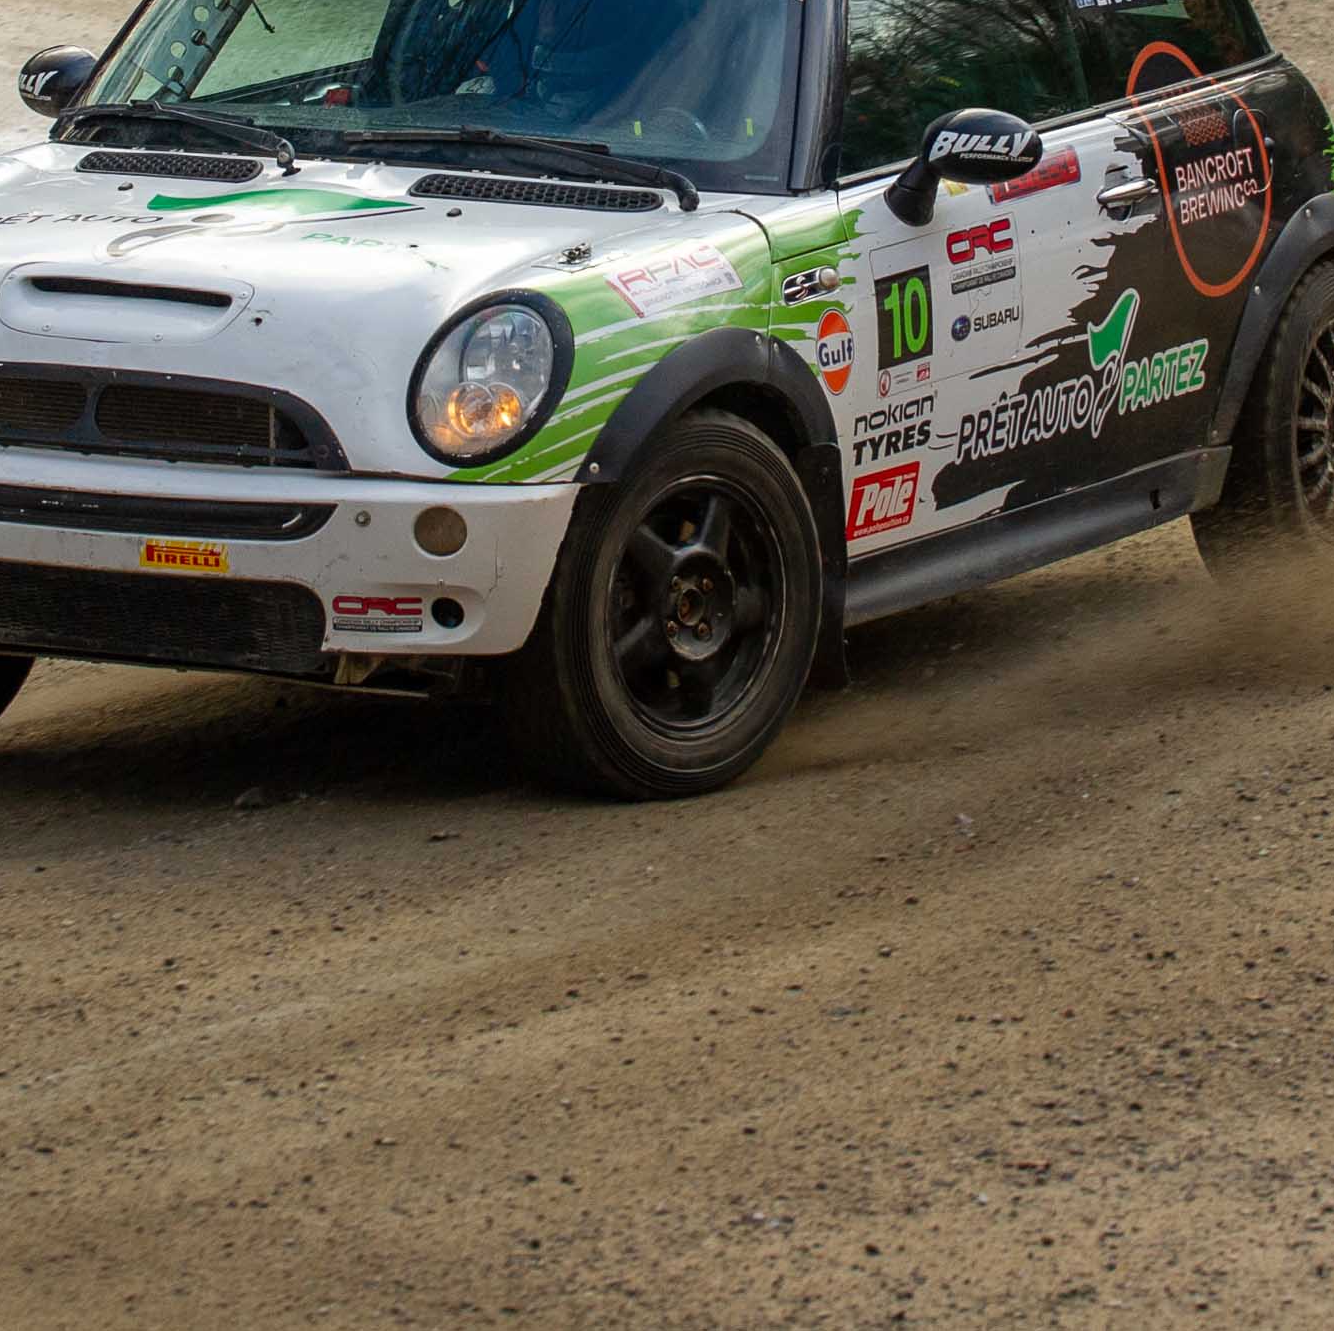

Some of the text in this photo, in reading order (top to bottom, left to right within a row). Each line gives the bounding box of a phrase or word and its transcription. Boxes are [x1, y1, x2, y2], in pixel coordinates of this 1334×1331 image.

[929, 130, 1033, 162] BULLY
[1175, 148, 1253, 192] BANCROFT
[946, 218, 1014, 265] CRC
[884, 277, 928, 359] 10
[973, 305, 1020, 332] SUBARU
[818, 338, 854, 368] Gulf
[1118, 338, 1209, 416] PARTEZ
[853, 420, 932, 467] TYRES
[145, 542, 220, 568] PIRELLI
